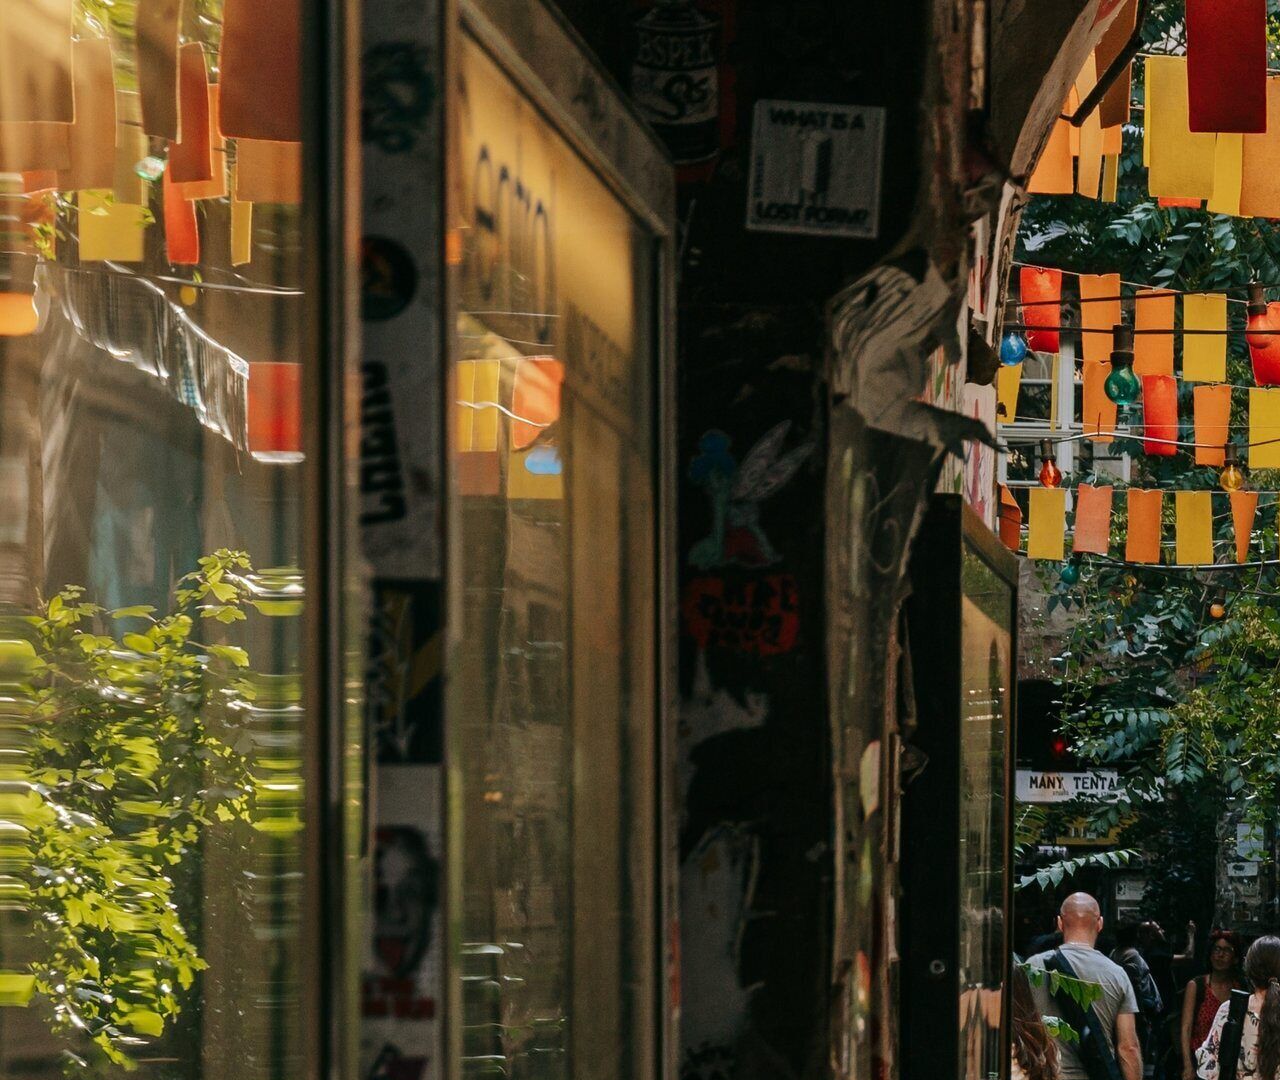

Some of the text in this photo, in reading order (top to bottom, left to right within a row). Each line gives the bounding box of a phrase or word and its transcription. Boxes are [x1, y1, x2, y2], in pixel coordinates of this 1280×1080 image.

[770, 108, 866, 130] WHAT IS A
[756, 202, 800, 222] LOST
[1029, 776, 1064, 790] MANY
